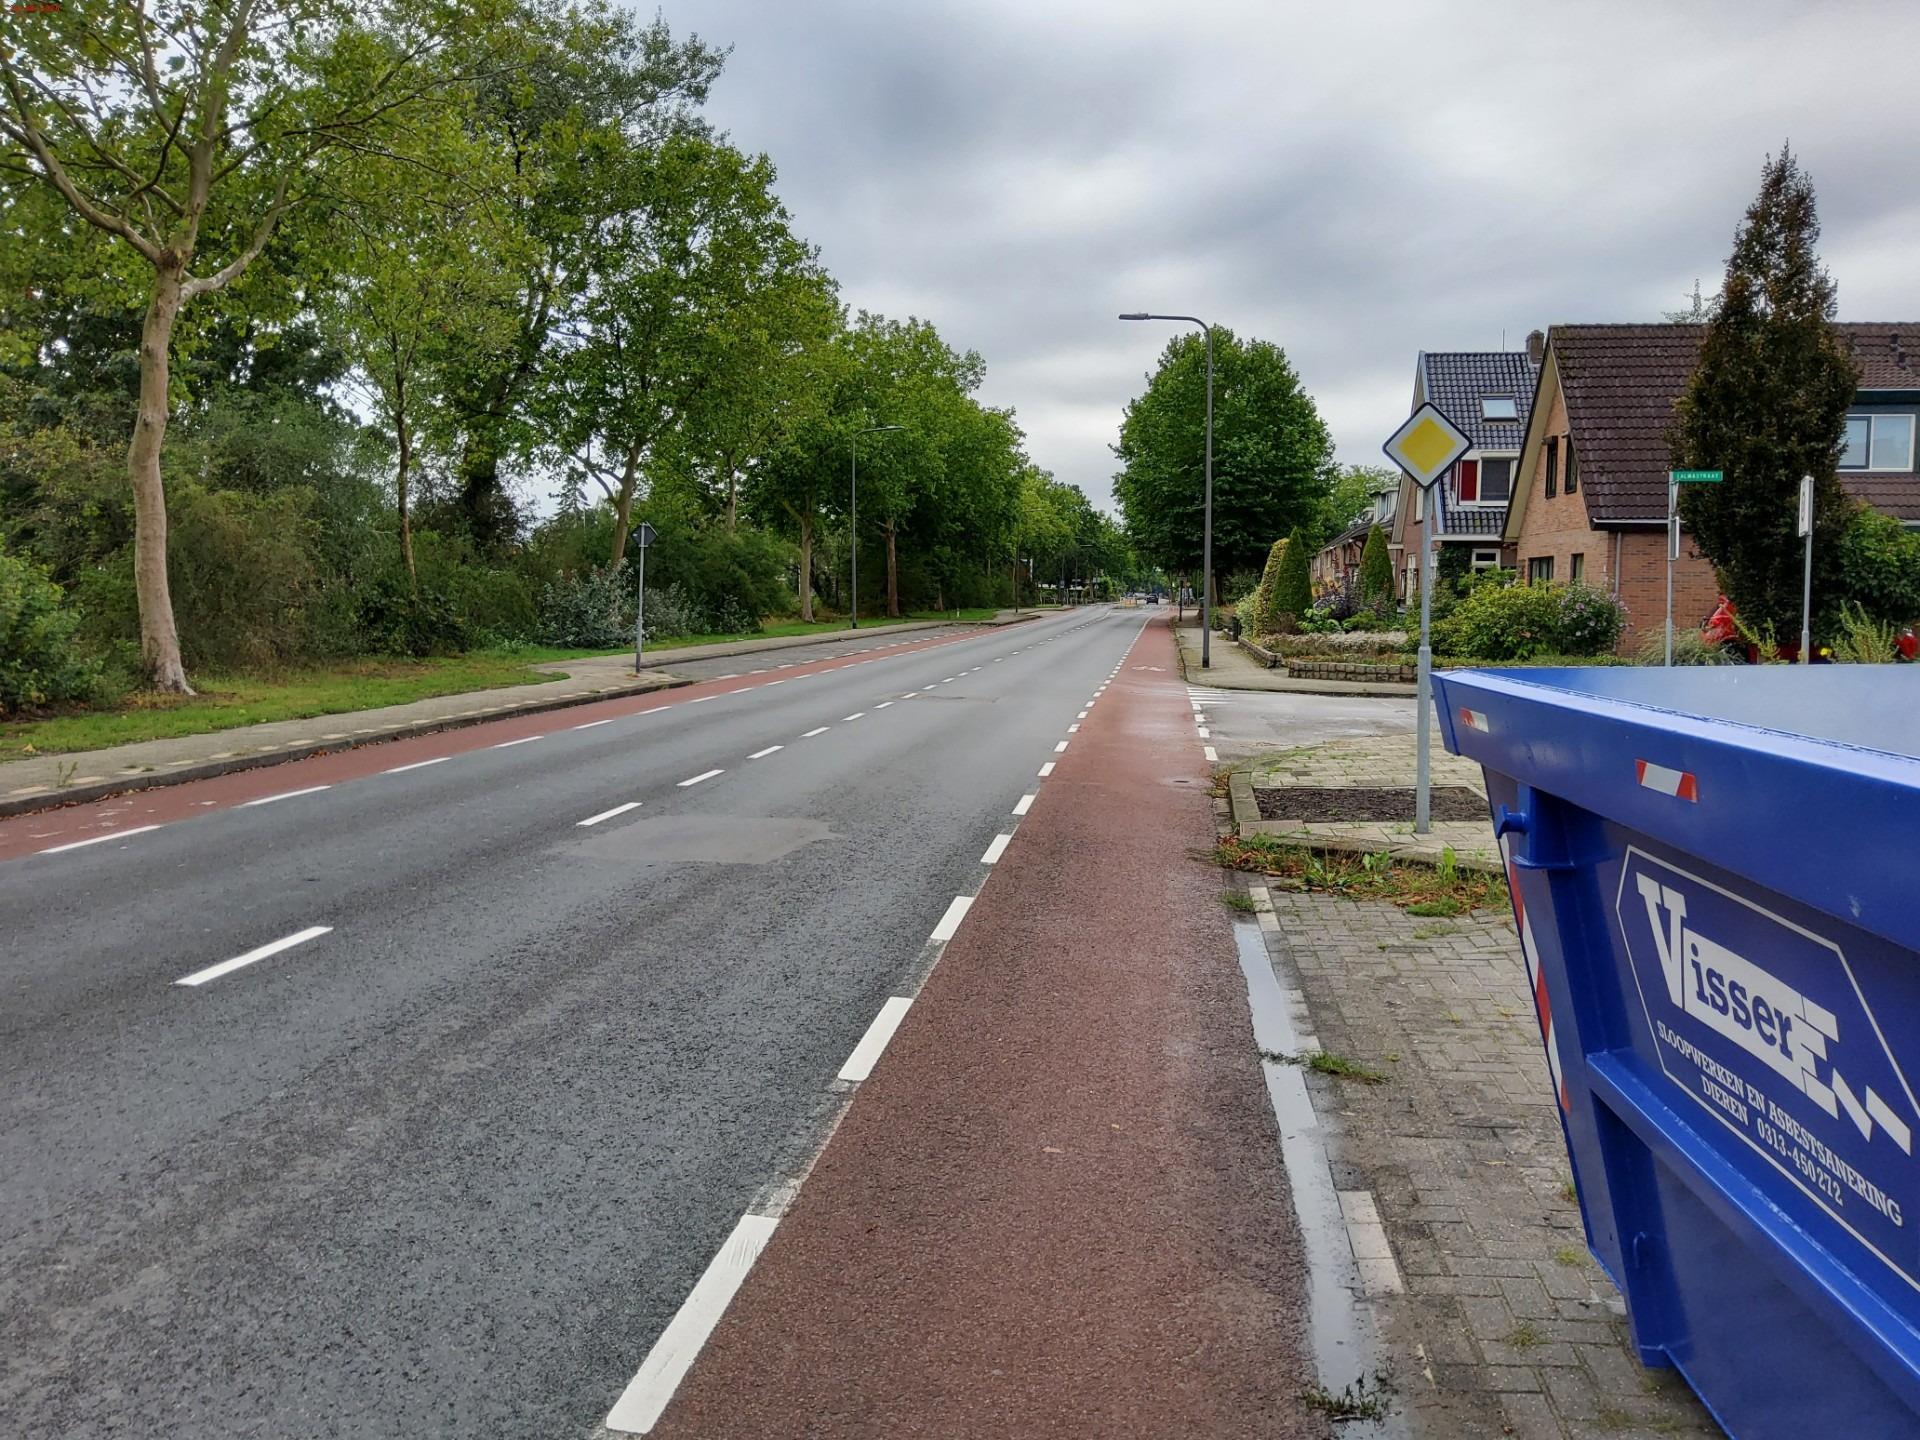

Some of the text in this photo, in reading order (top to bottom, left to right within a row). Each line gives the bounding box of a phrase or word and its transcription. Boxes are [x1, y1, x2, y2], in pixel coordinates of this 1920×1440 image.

[1636, 872, 1793, 1062] Visser
[1657, 1020, 1902, 1226] SLOOPWERKEN EN ASBESTSANERING
[1701, 1074, 1748, 1126] DIEREN
